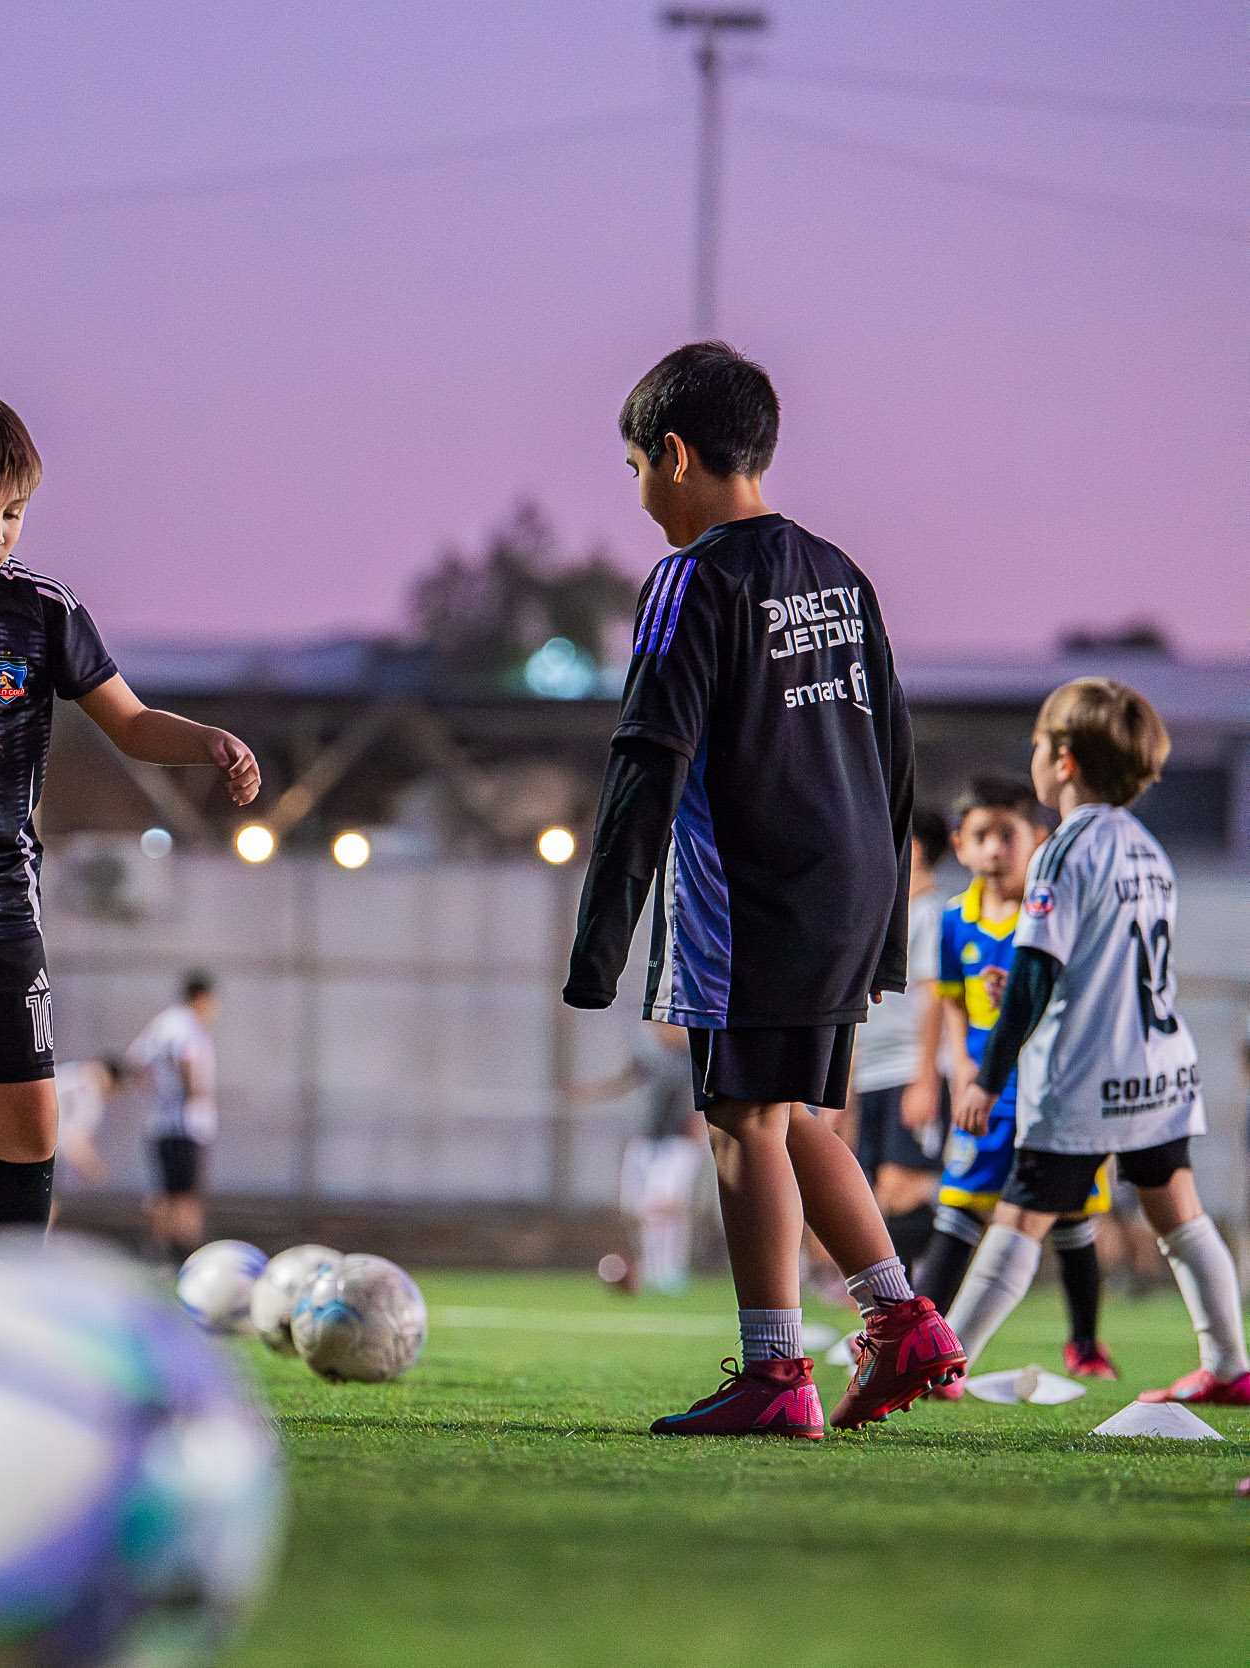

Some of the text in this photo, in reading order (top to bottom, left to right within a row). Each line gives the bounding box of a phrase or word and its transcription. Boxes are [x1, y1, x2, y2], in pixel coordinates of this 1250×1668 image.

[759, 586, 860, 633] DIRECTV
[770, 619, 864, 659] JETOUR
[784, 677, 848, 708] smart
[25, 991, 54, 1053] 10
